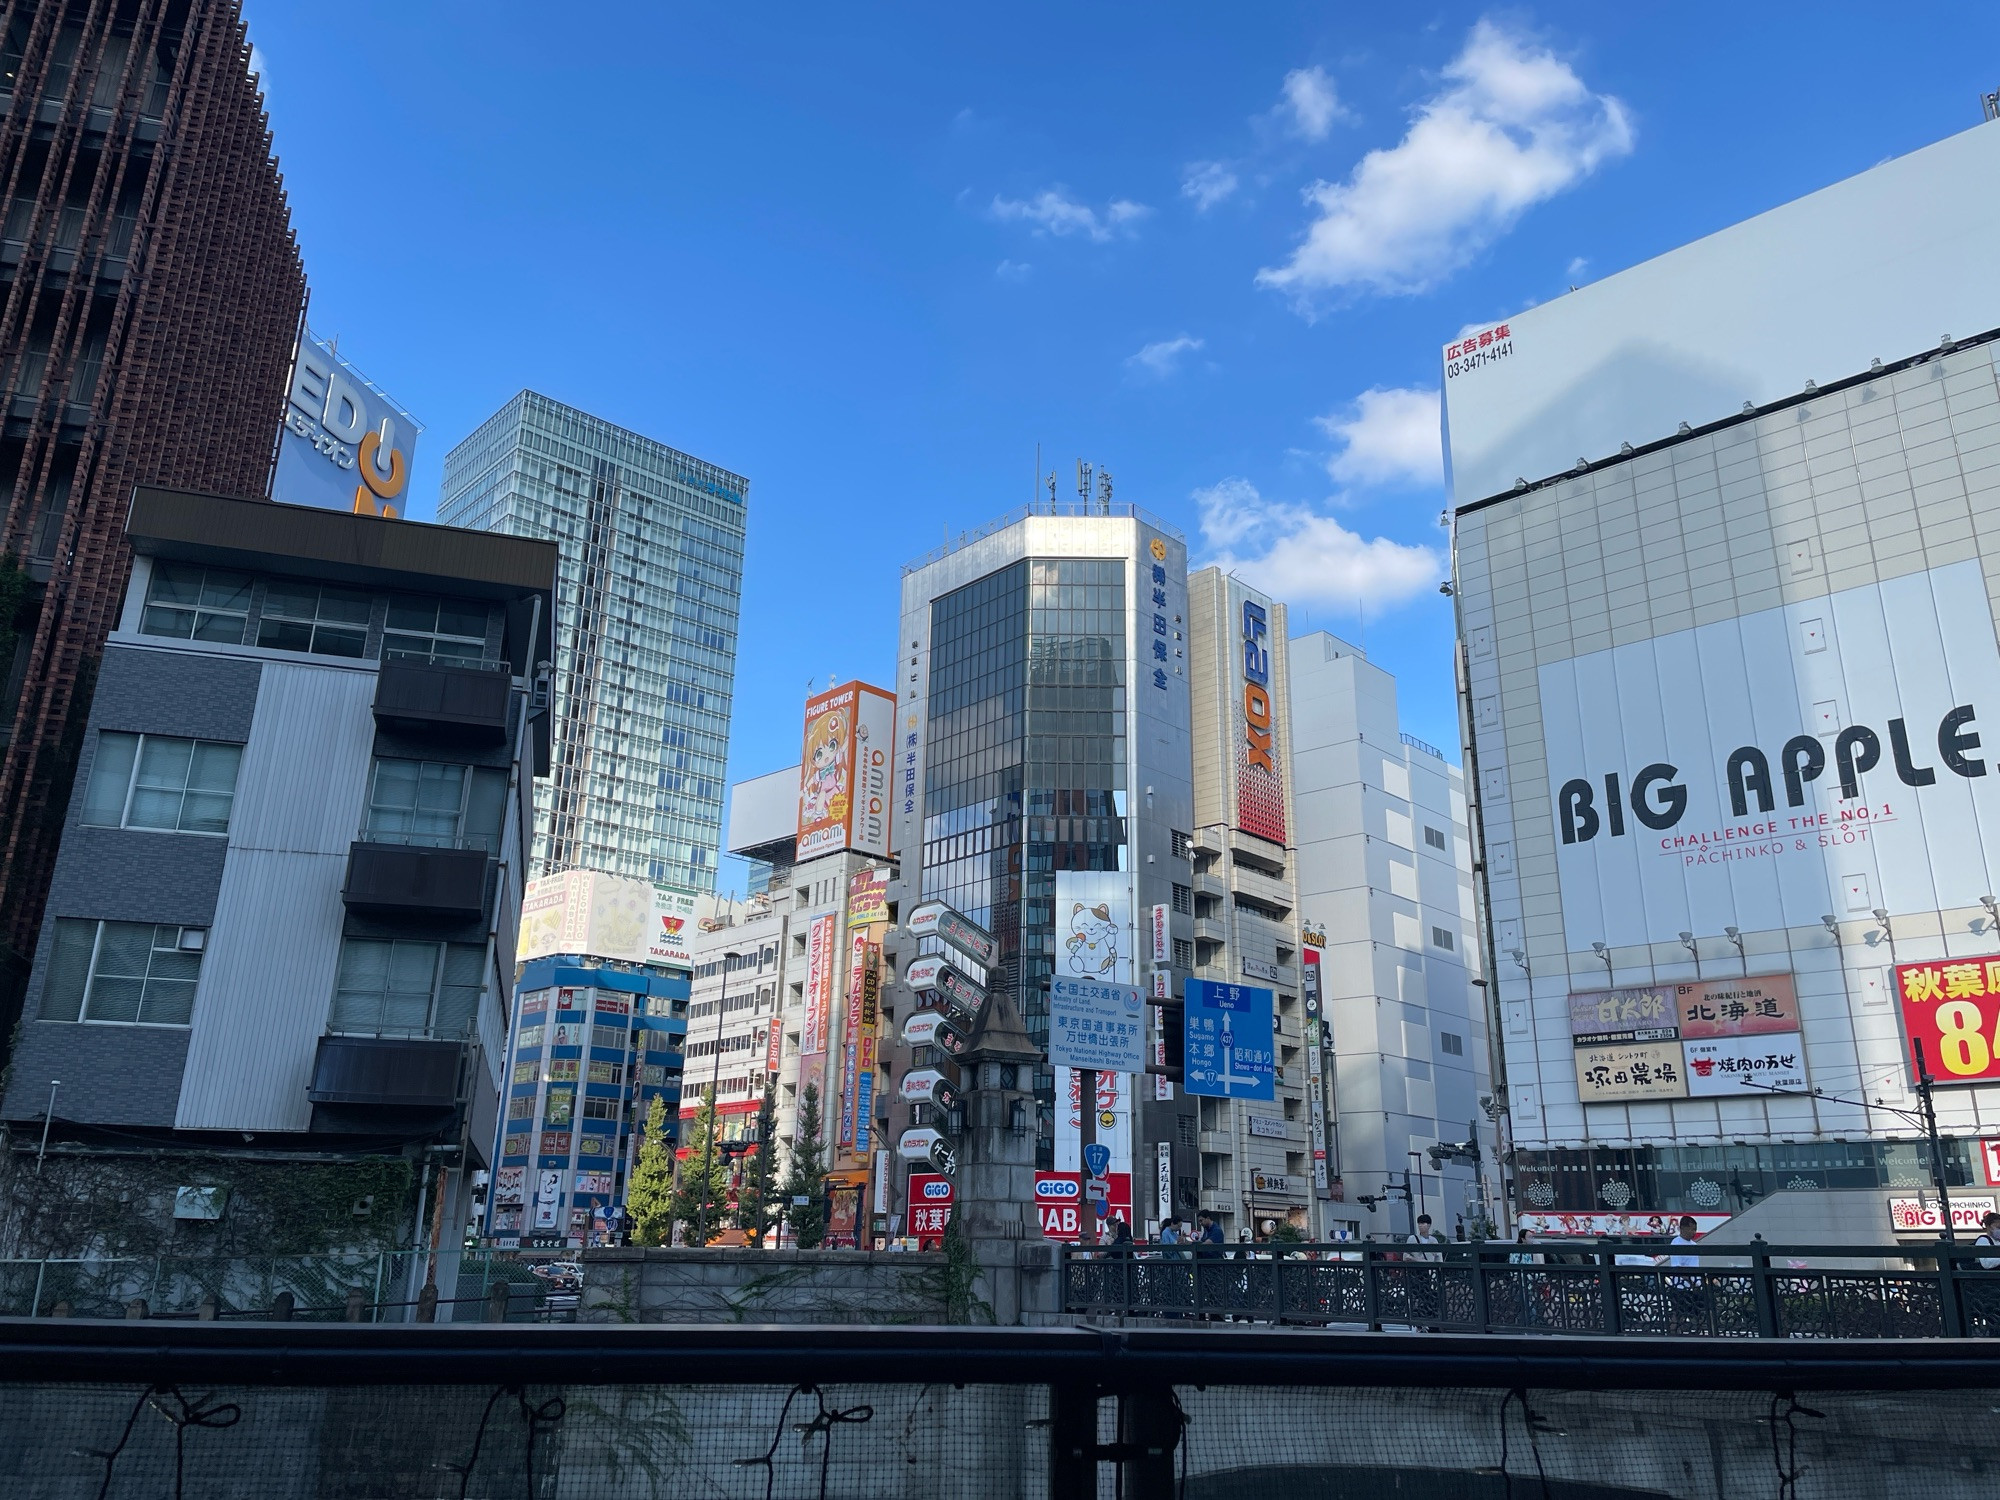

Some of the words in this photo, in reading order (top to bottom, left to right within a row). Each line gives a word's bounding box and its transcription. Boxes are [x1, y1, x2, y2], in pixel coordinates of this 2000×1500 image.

[1447, 324, 1511, 361] 広告募集
[1447, 340, 1513, 379] 03-3471-4141
[806, 702, 828, 718] FIGURE
[830, 690, 853, 708] TOWER
[867, 749, 885, 846] amiami
[1559, 762, 1688, 846] BIG
[801, 822, 843, 848] amiami
[1660, 821, 1778, 850] CHALLENGE
[1788, 812, 1829, 830] THE
[1685, 842, 1784, 867] PACHINKO
[1795, 839, 1808, 851] &
[1817, 829, 1870, 848] SLOT
[525, 894, 564, 912] TAKARADA
[657, 893, 673, 902] TAX
[677, 897, 694, 906] FREE
[649, 946, 691, 961] TAKARADA
[1069, 983, 1122, 1001] 国土交通省
[1213, 985, 1240, 1001] 上野
[1677, 986, 1693, 995] 8F
[1703, 989, 1762, 1001] 北の味紀行と地酒
[1085, 1006, 1094, 1014] and
[1095, 1008, 1117, 1017] Transport
[1219, 1001, 1234, 1009] Ueno
[1686, 997, 1785, 1021] 北海道
[1057, 1015, 1138, 1037] 東京国道事務所
[1189, 1016, 1214, 1032] 巣鴨
[1066, 1030, 1130, 1049] 万世橋出張所
[1189, 1031, 1215, 1041] Sugamo
[770, 1026, 779, 1063] FIGURE
[1055, 1045, 1073, 1054] Tokyo
[1073, 1047, 1097, 1056] National
[1098, 1050, 1121, 1059] Highway
[1123, 1052, 1140, 1060] Office
[1189, 1042, 1215, 1058] 本郷
[1105, 1057, 1126, 1067] Branch
[1191, 1058, 1212, 1067] Hongo
[1234, 1047, 1272, 1064] 昭和通り
[1589, 1053, 1615, 1063] 北海道
[1717, 1053, 1797, 1073] 焼肉の万世
[1234, 1062, 1263, 1072] Showa-dori
[1206, 1072, 1214, 1081] 17
[1584, 1062, 1678, 1089] 塚田農場
[1092, 1152, 1103, 1165] 17
[1879, 1156, 1929, 1167] Welcome!
[1519, 1164, 1558, 1172] Welcome!
[1904, 1210, 1936, 1226] BIG
[532, 1238, 561, 1249] 富士そば
